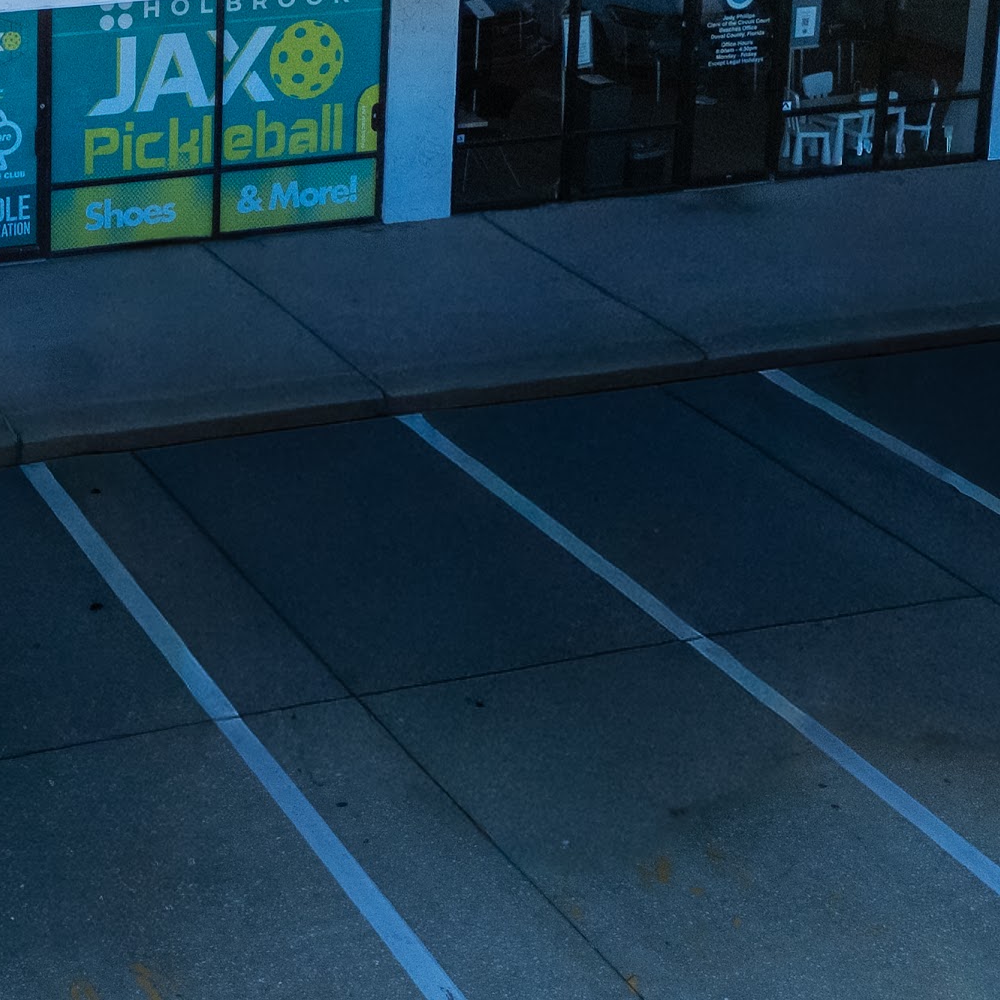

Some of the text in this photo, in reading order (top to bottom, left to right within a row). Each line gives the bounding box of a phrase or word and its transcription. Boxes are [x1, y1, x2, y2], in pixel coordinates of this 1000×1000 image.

[86, 25, 278, 117] JAX
[84, 103, 344, 176] Pickleball
[3, 171, 26, 179] CLUB
[235, 174, 359, 214] & More!
[84, 198, 177, 231] Shoes
